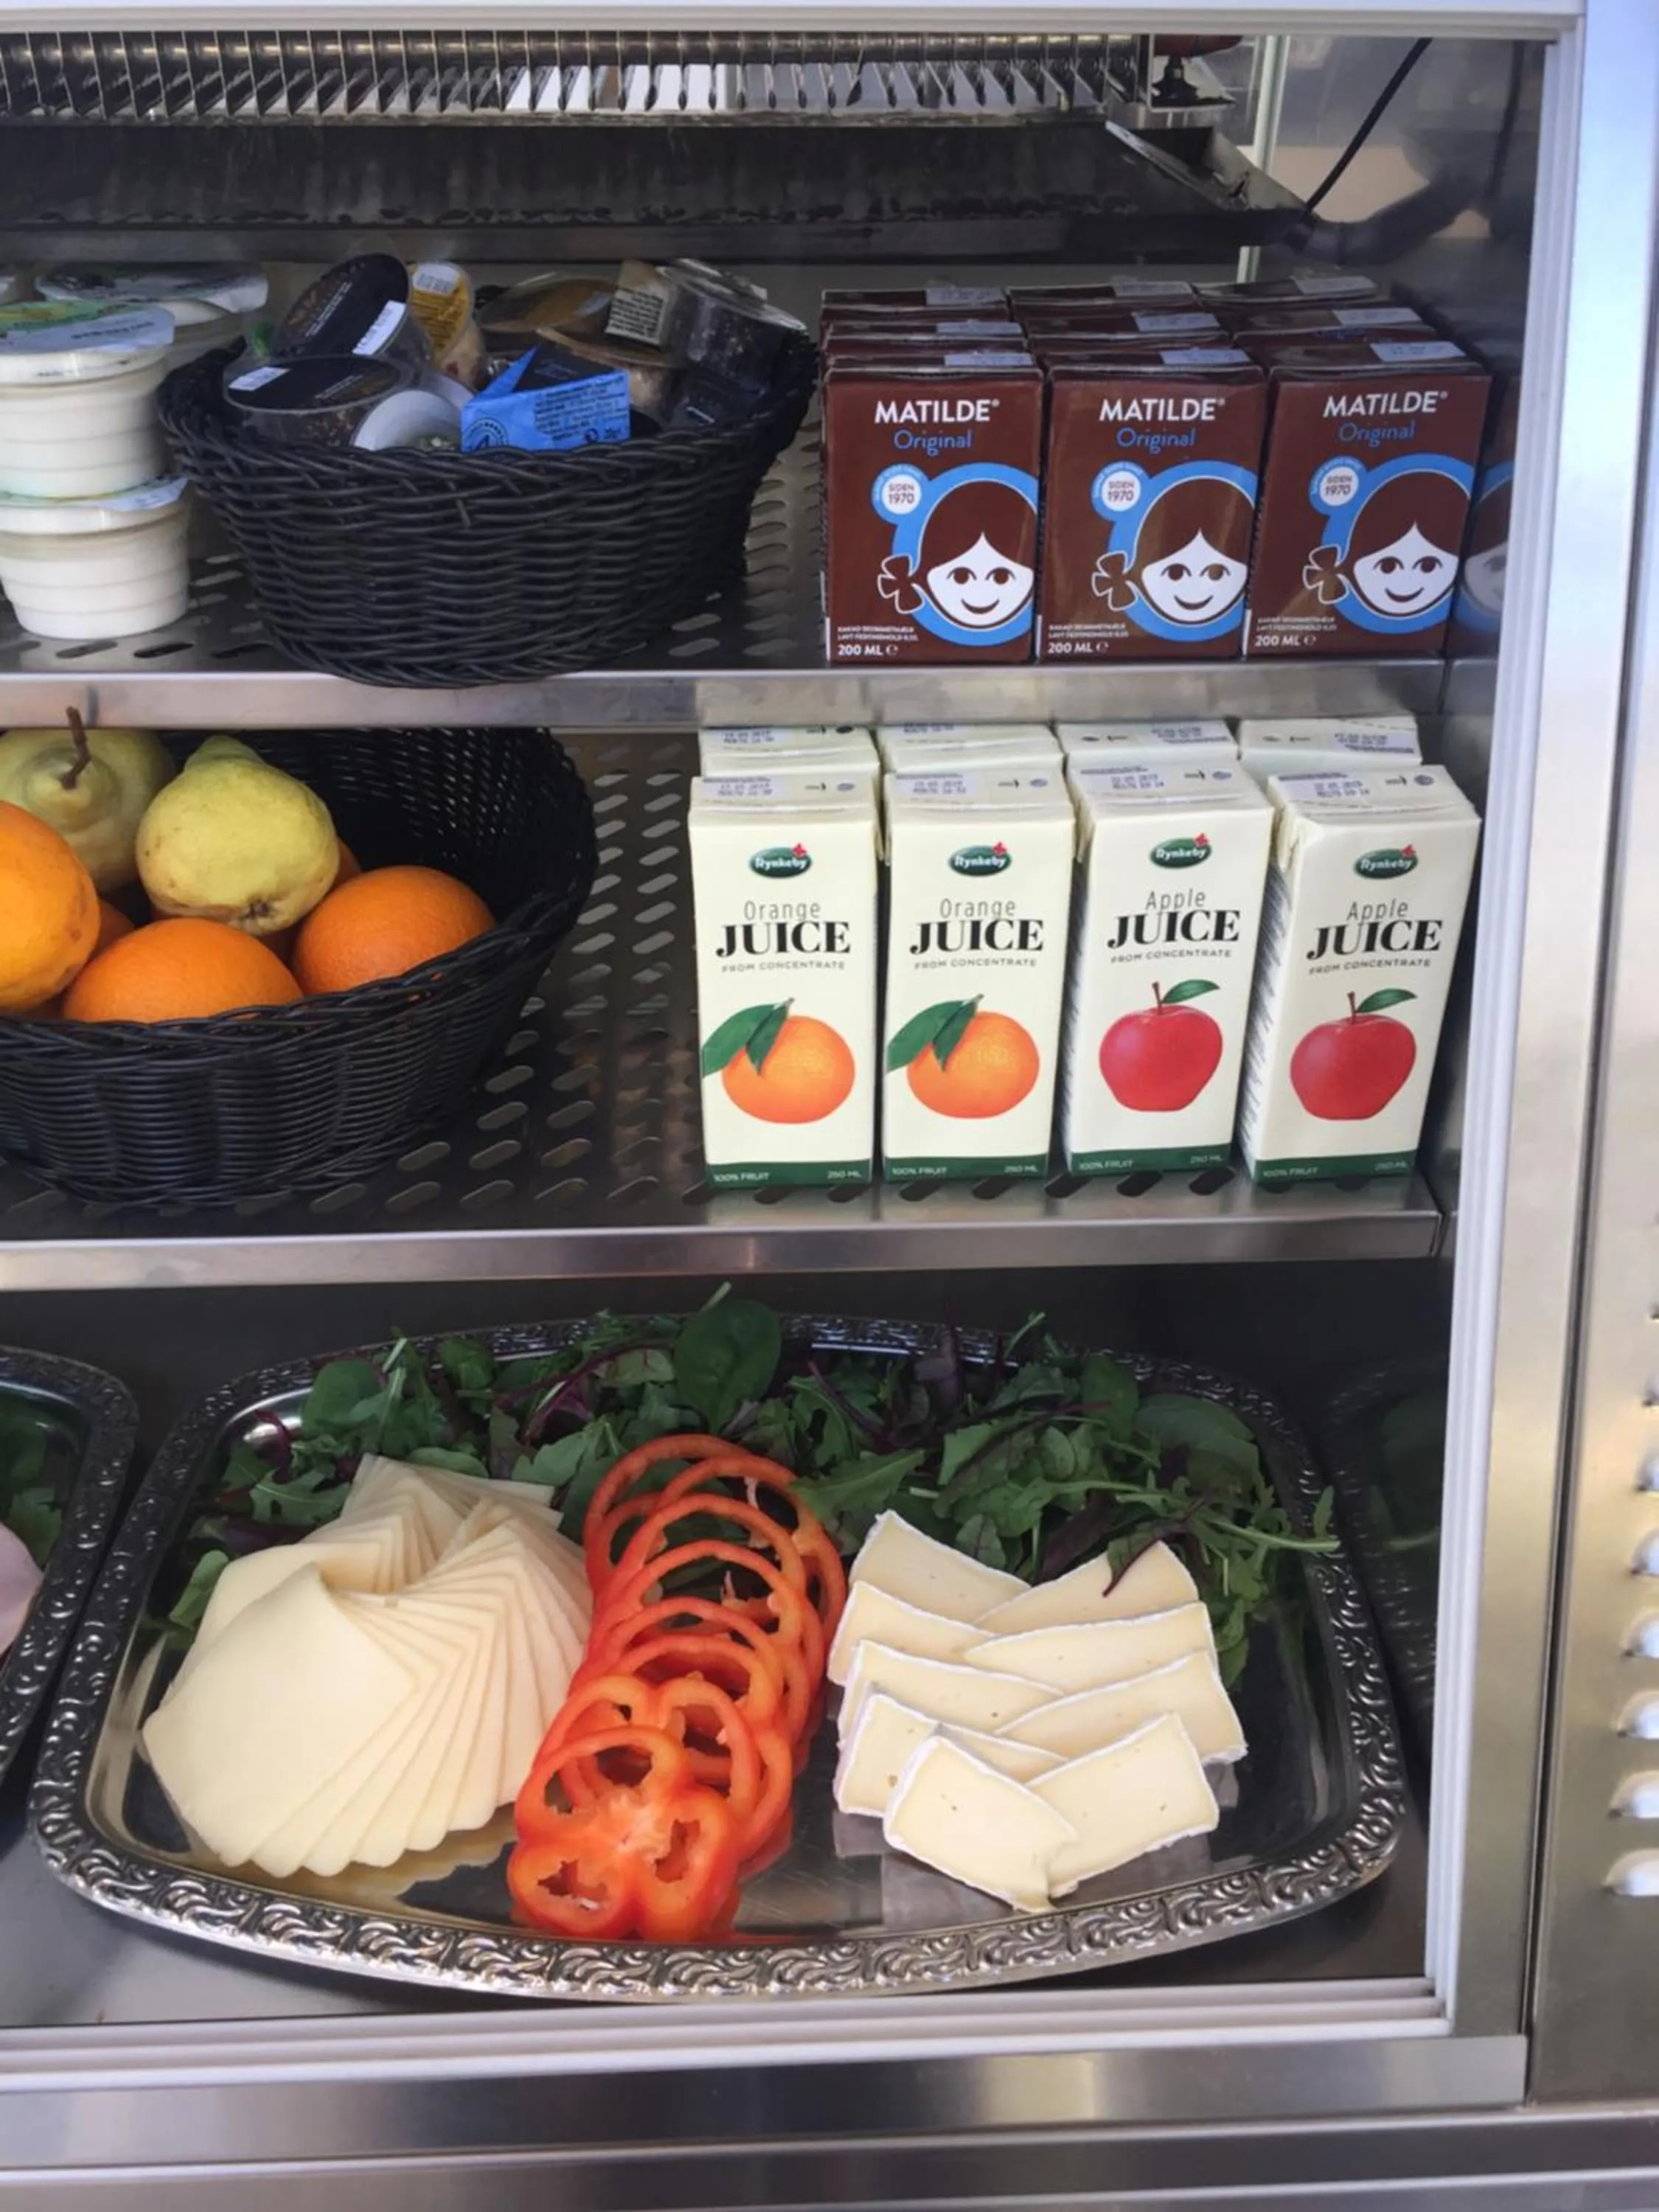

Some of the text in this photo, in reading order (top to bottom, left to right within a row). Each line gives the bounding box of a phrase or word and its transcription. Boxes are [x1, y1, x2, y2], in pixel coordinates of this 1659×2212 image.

[1116, 426, 1196, 454] Original
[1338, 419, 1416, 448] Original
[894, 428, 972, 456] Original
[888, 484, 914, 492] SIDEN
[1324, 484, 1351, 495] 1970
[888, 493, 915, 504] 1970
[1107, 490, 1134, 501] 1970
[1048, 641, 1093, 653] 200 ML
[1254, 635, 1300, 647] 200 ML
[838, 644, 883, 655] 200 ML
[1155, 847, 1206, 861] Rynkeby
[754, 857, 807, 870] Rynkeby
[954, 855, 1006, 869] Rynkeby
[1360, 858, 1412, 872] Rynkeby
[1145, 888, 1206, 914] Apple
[744, 900, 821, 921] Orange
[939, 898, 1015, 919] Orange
[1346, 898, 1408, 923] Apple
[1107, 909, 1240, 948] JUICE
[716, 921, 851, 957] JUICE
[909, 919, 1044, 955] JUICE
[1306, 919, 1443, 961] JUICE
[1111, 949, 1231, 963] FROM CONCENTRATE
[721, 961, 845, 973] FROM CONCENTRATE
[914, 959, 1037, 970] FROM CONCENTRATE
[1309, 959, 1430, 974] FROM CONCENTRATE
[714, 1172, 770, 1182] 100% FRUIT
[892, 1166, 947, 1175] 100% FRUIT
